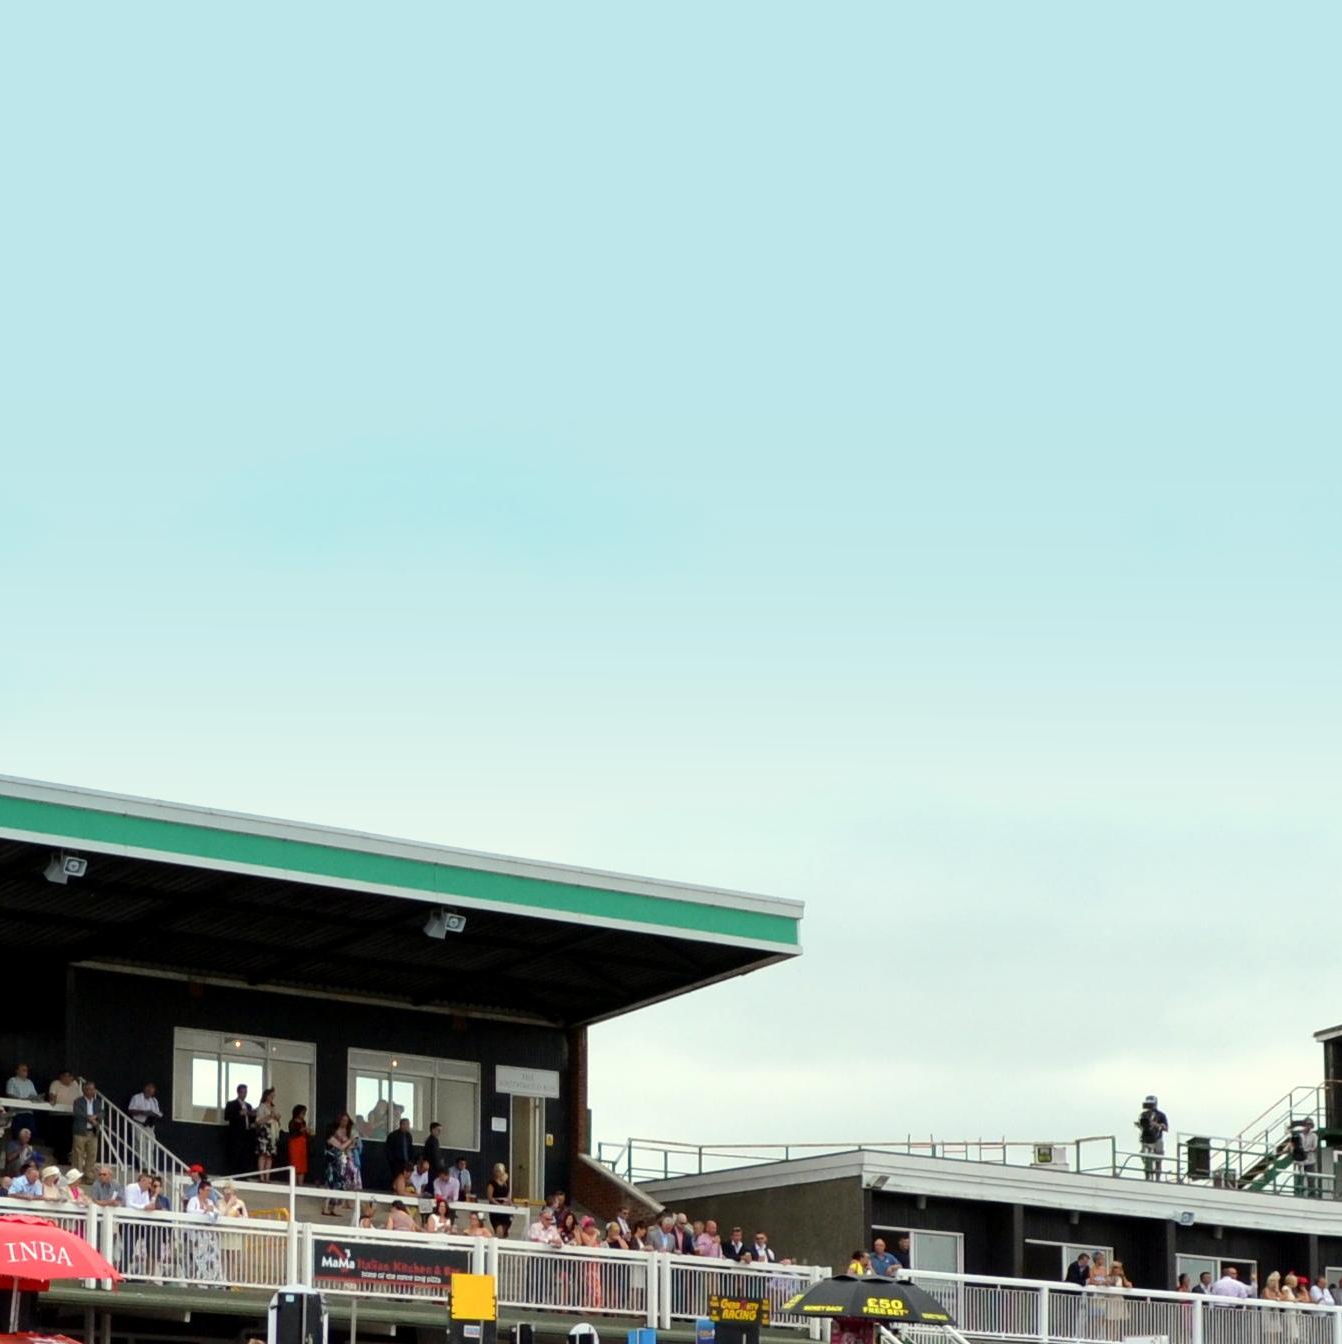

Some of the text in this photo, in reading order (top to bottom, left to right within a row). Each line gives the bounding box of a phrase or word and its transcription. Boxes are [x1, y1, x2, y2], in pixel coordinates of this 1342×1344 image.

[4, 1240, 74, 1267] INBA
[321, 1255, 355, 1270] MaMa
[862, 1306, 889, 1314] FREE
[866, 1297, 904, 1310] £50
[721, 1309, 758, 1322] RACING
